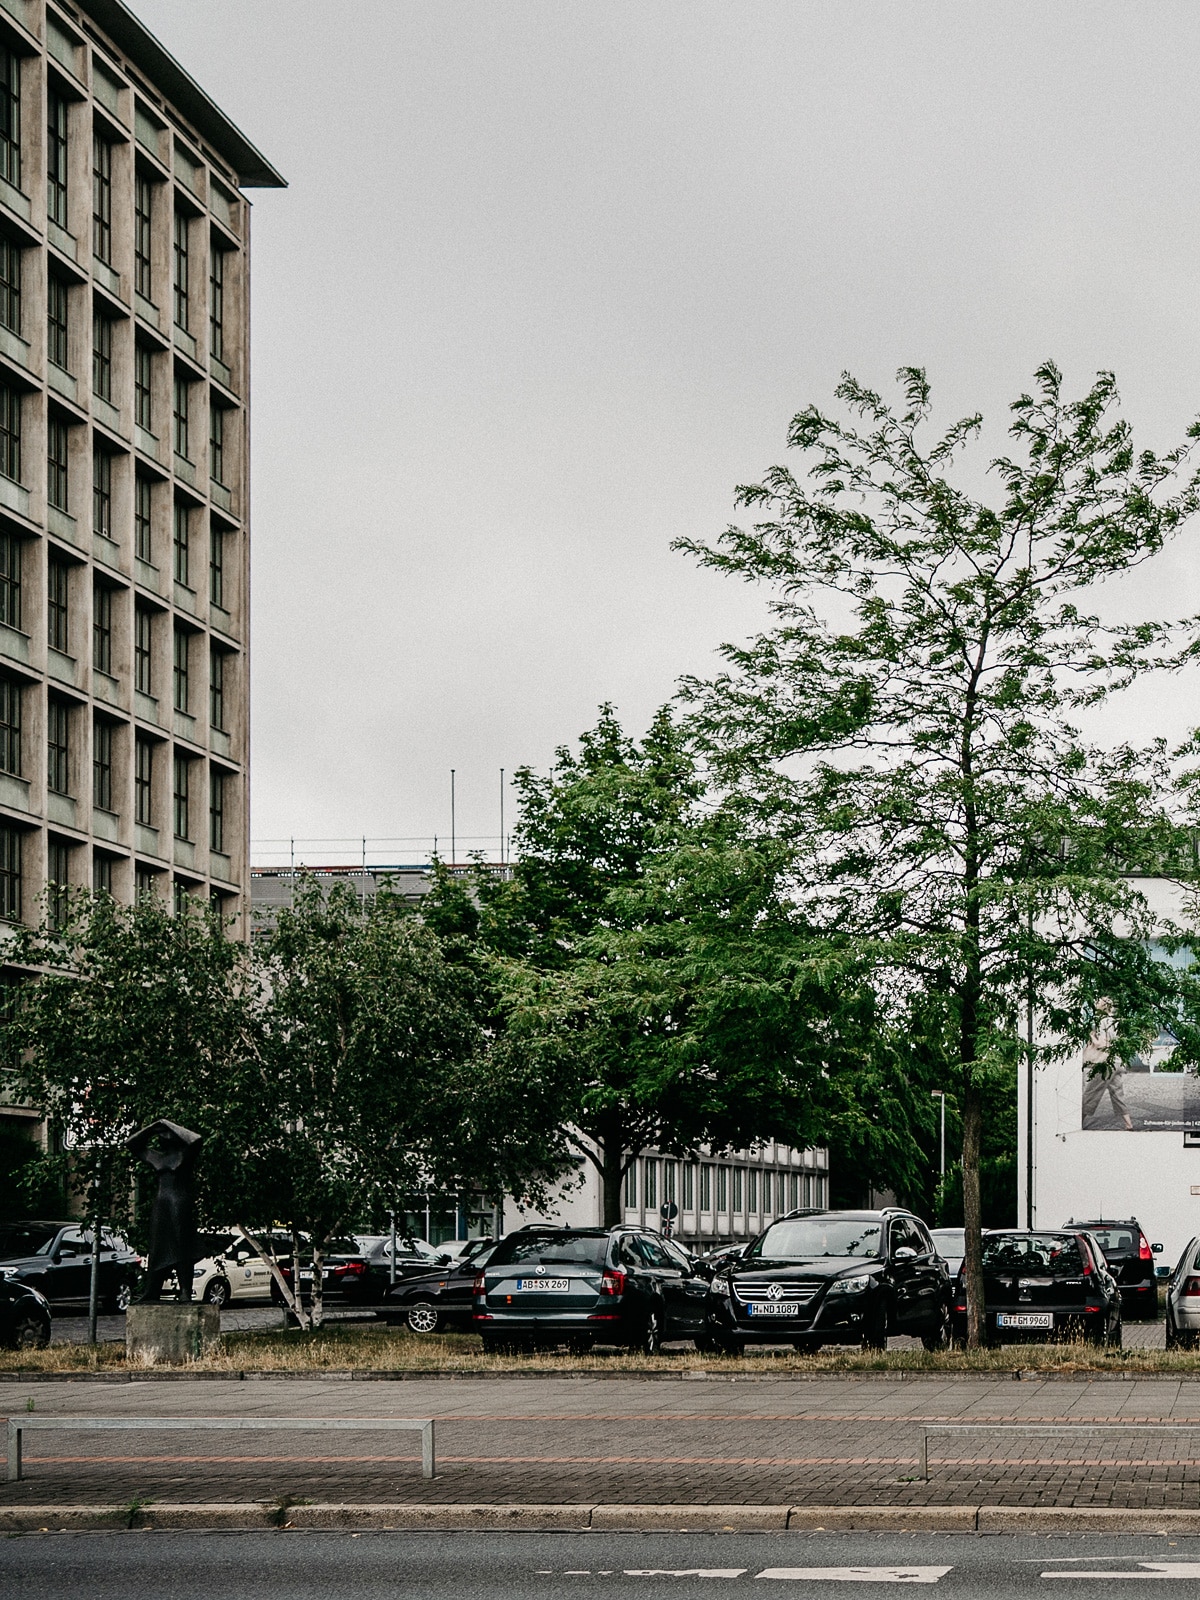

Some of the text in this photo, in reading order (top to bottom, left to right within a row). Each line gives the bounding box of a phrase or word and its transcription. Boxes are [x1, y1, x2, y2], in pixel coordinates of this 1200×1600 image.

[522, 1280, 568, 1289] AB SX 269
[776, 1304, 798, 1314] 1087
[1029, 1315, 1048, 1325] 9966
